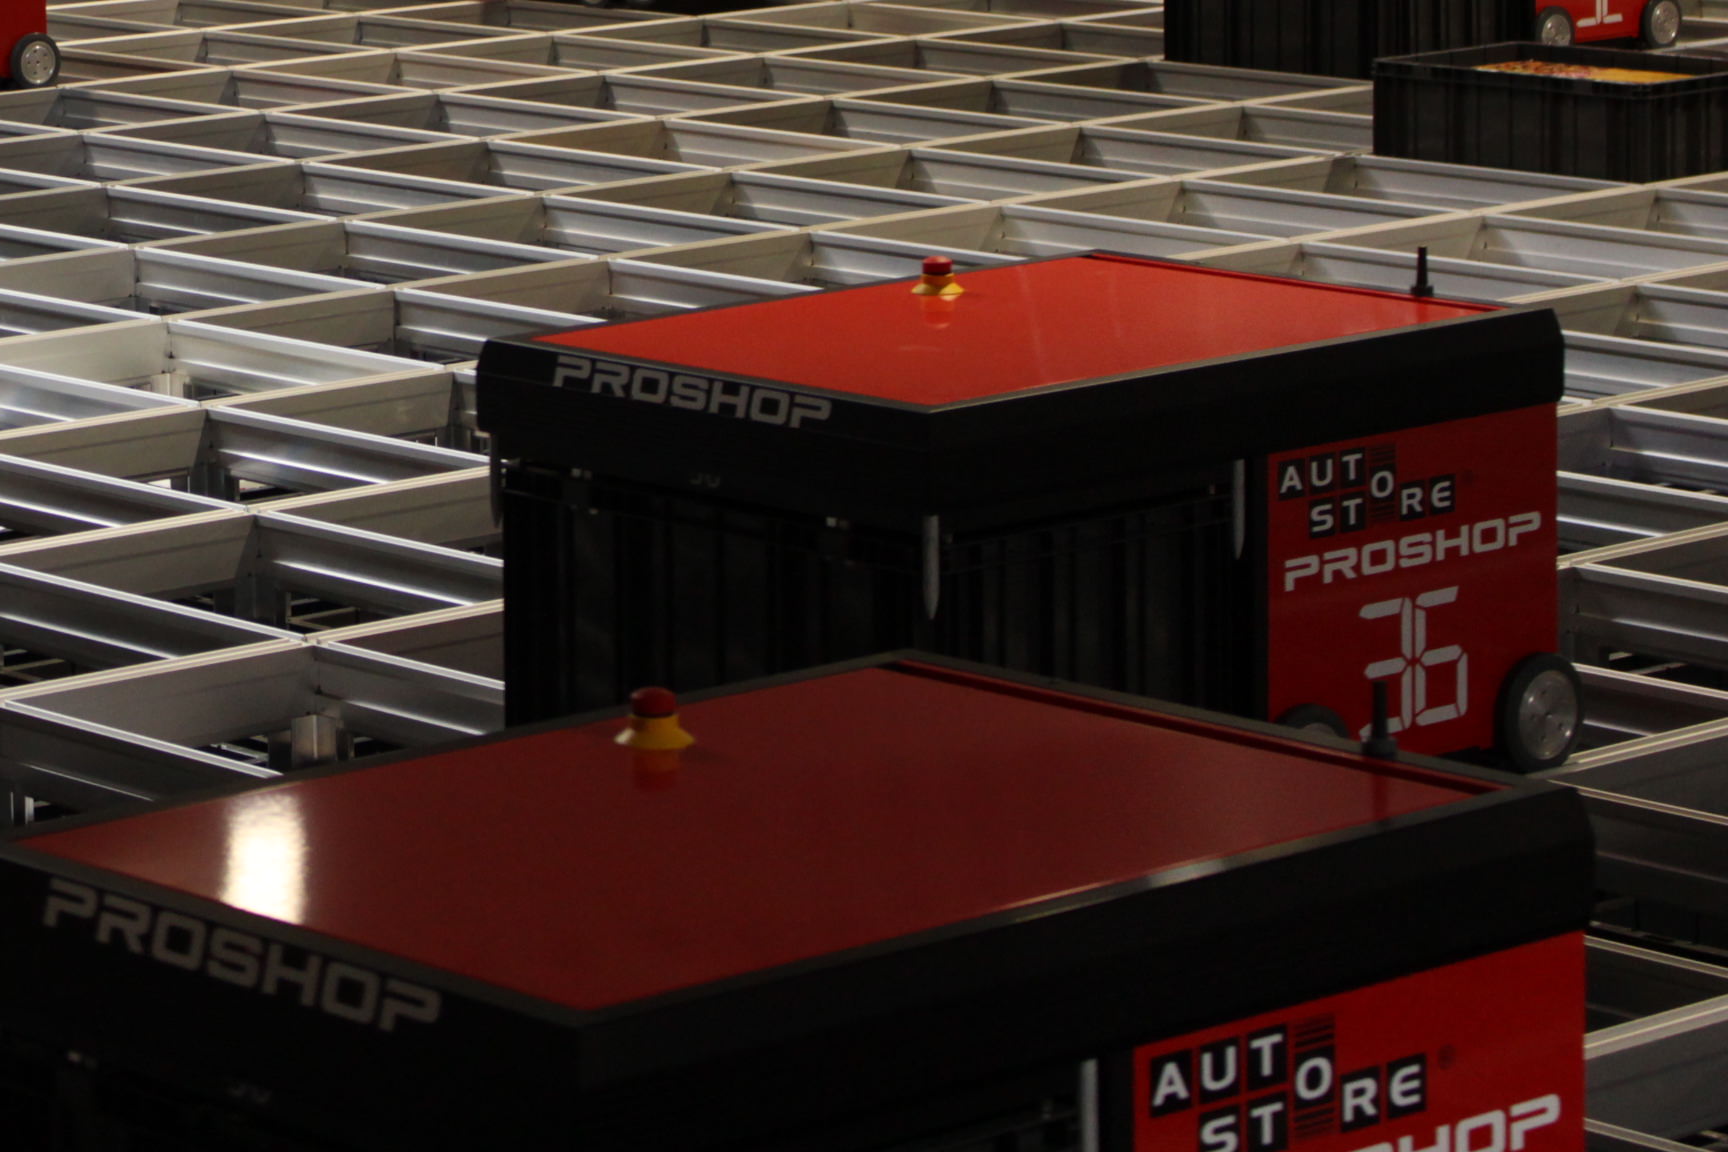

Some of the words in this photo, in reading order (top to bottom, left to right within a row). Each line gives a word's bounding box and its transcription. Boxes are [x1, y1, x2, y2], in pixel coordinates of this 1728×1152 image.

[552, 354, 833, 429] PROSHOP
[1284, 511, 1542, 592] PROSHOP
[1359, 585, 1468, 743] 36
[42, 876, 444, 1034] PROSHOP
